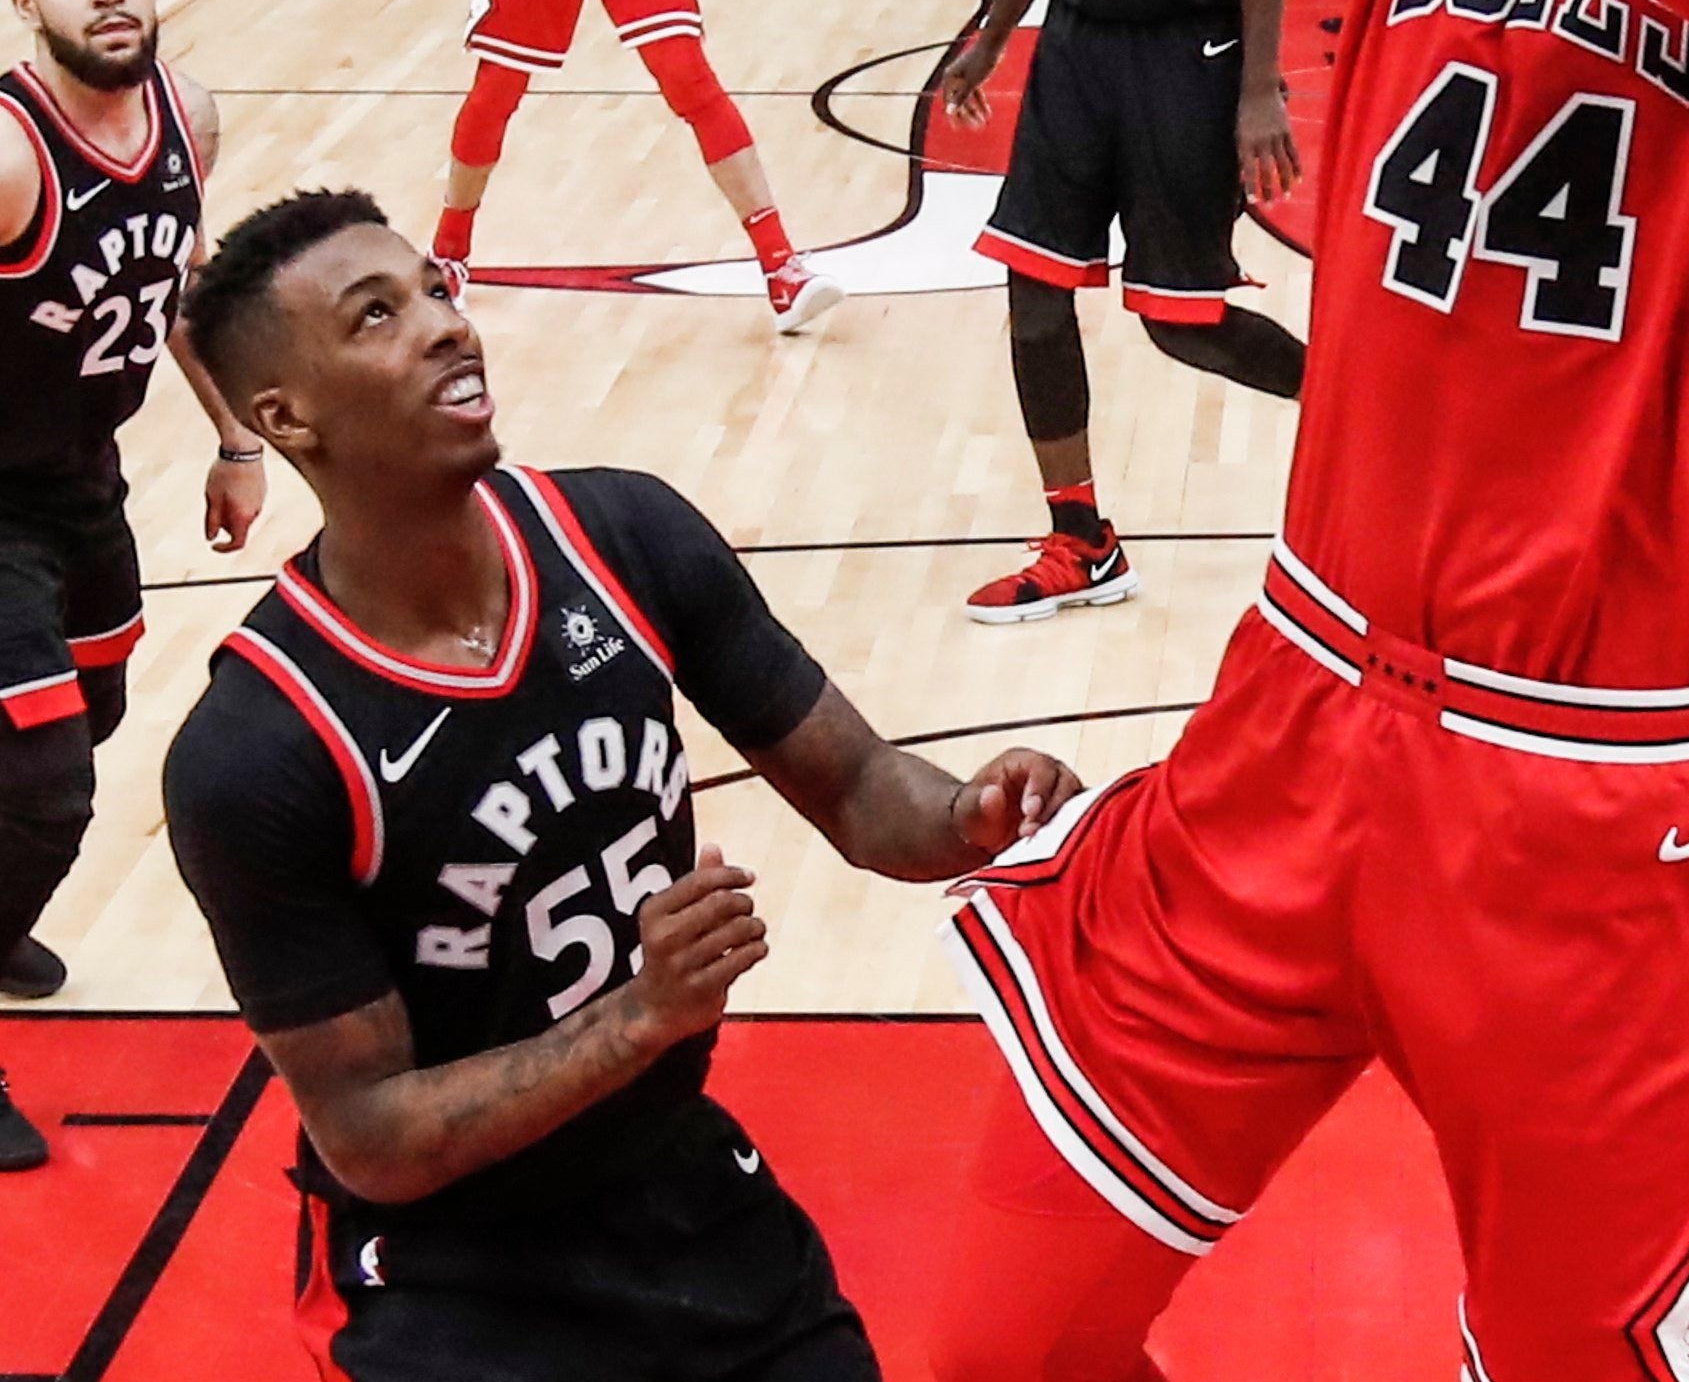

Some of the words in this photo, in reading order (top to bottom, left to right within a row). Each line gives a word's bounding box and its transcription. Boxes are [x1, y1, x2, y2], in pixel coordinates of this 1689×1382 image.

[1363, 59, 1637, 343] 44
[79, 277, 174, 377] 23
[568, 656, 601, 681] Sun
[595, 637, 625, 663] Life
